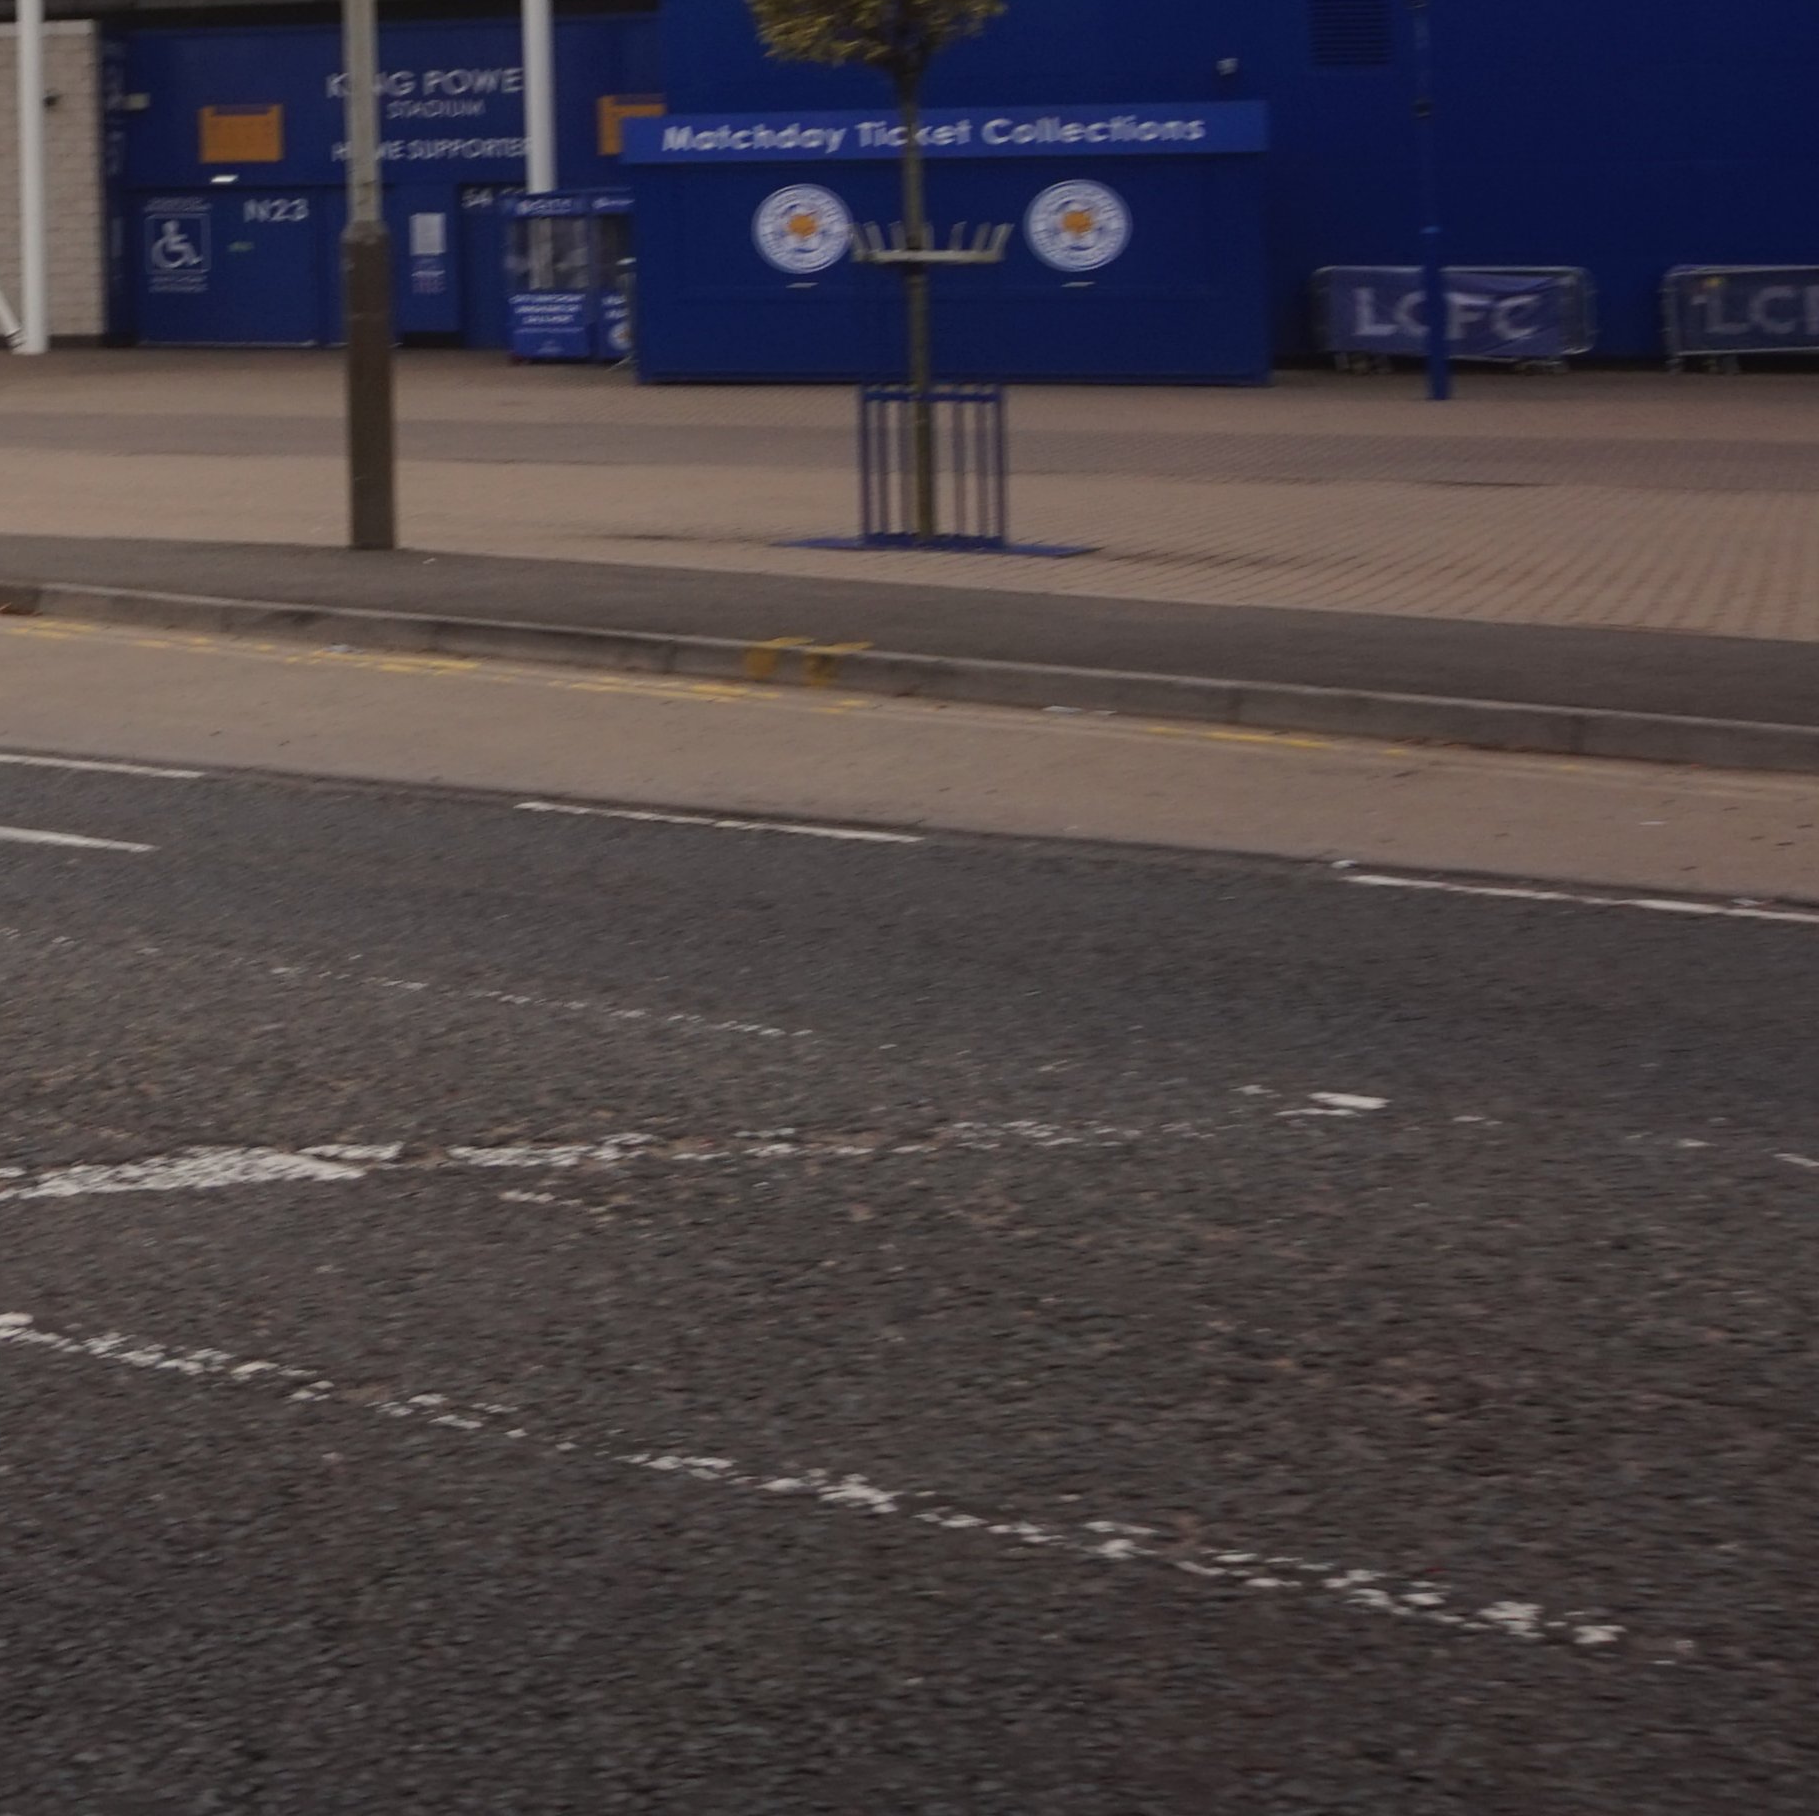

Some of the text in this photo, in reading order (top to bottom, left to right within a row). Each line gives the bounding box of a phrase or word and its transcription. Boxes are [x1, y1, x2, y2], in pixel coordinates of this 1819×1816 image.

[423, 67, 525, 96] POWE
[386, 98, 486, 120] STADIUM
[662, 122, 847, 154] Matchday
[981, 114, 1206, 145] Collections
